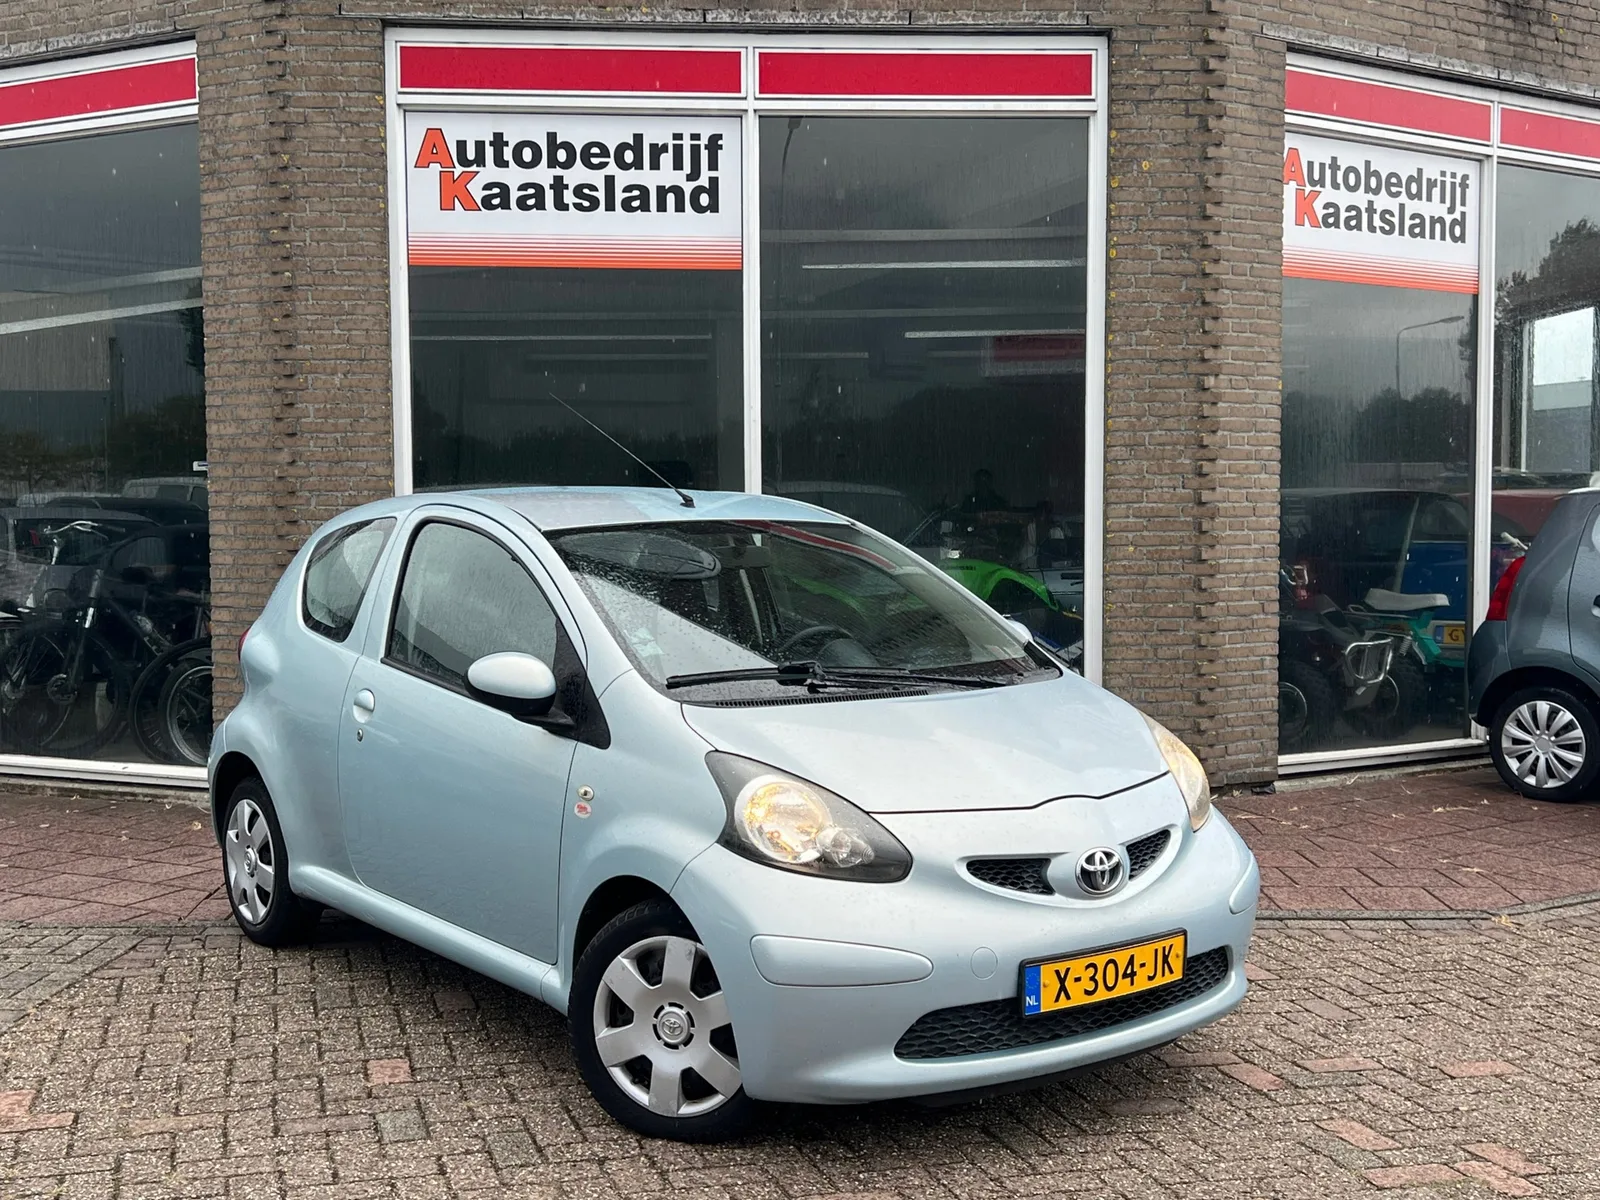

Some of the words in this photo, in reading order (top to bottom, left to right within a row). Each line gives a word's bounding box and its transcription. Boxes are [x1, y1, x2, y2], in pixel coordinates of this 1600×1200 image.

[414, 128, 724, 182] Autobedrijf
[1283, 147, 1470, 215] Autobedrijf
[439, 170, 720, 214] Kaatsland
[1295, 188, 1467, 244] Kaatsland
[1026, 995, 1039, 1006] NL
[1054, 944, 1175, 1003] X-304-JK
